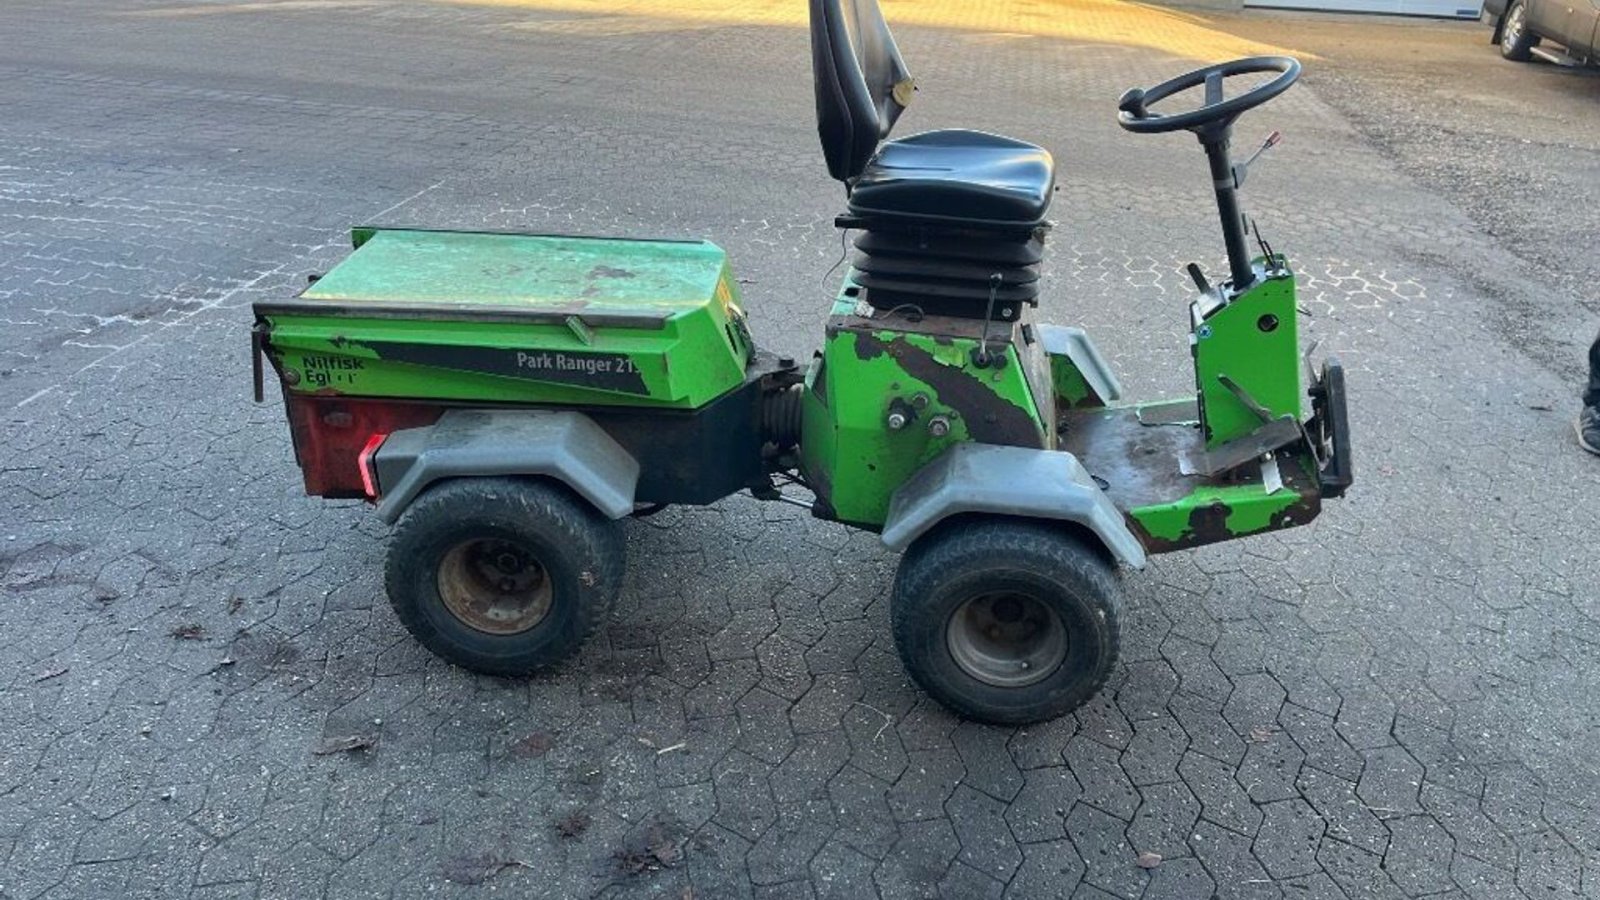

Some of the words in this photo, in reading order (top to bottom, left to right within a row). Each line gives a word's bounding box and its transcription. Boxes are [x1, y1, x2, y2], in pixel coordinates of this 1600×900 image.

[303, 356, 365, 370] Nilfisk
[517, 352, 553, 369] Park
[556, 353, 612, 375] Ranger
[615, 357, 640, 374] 21
